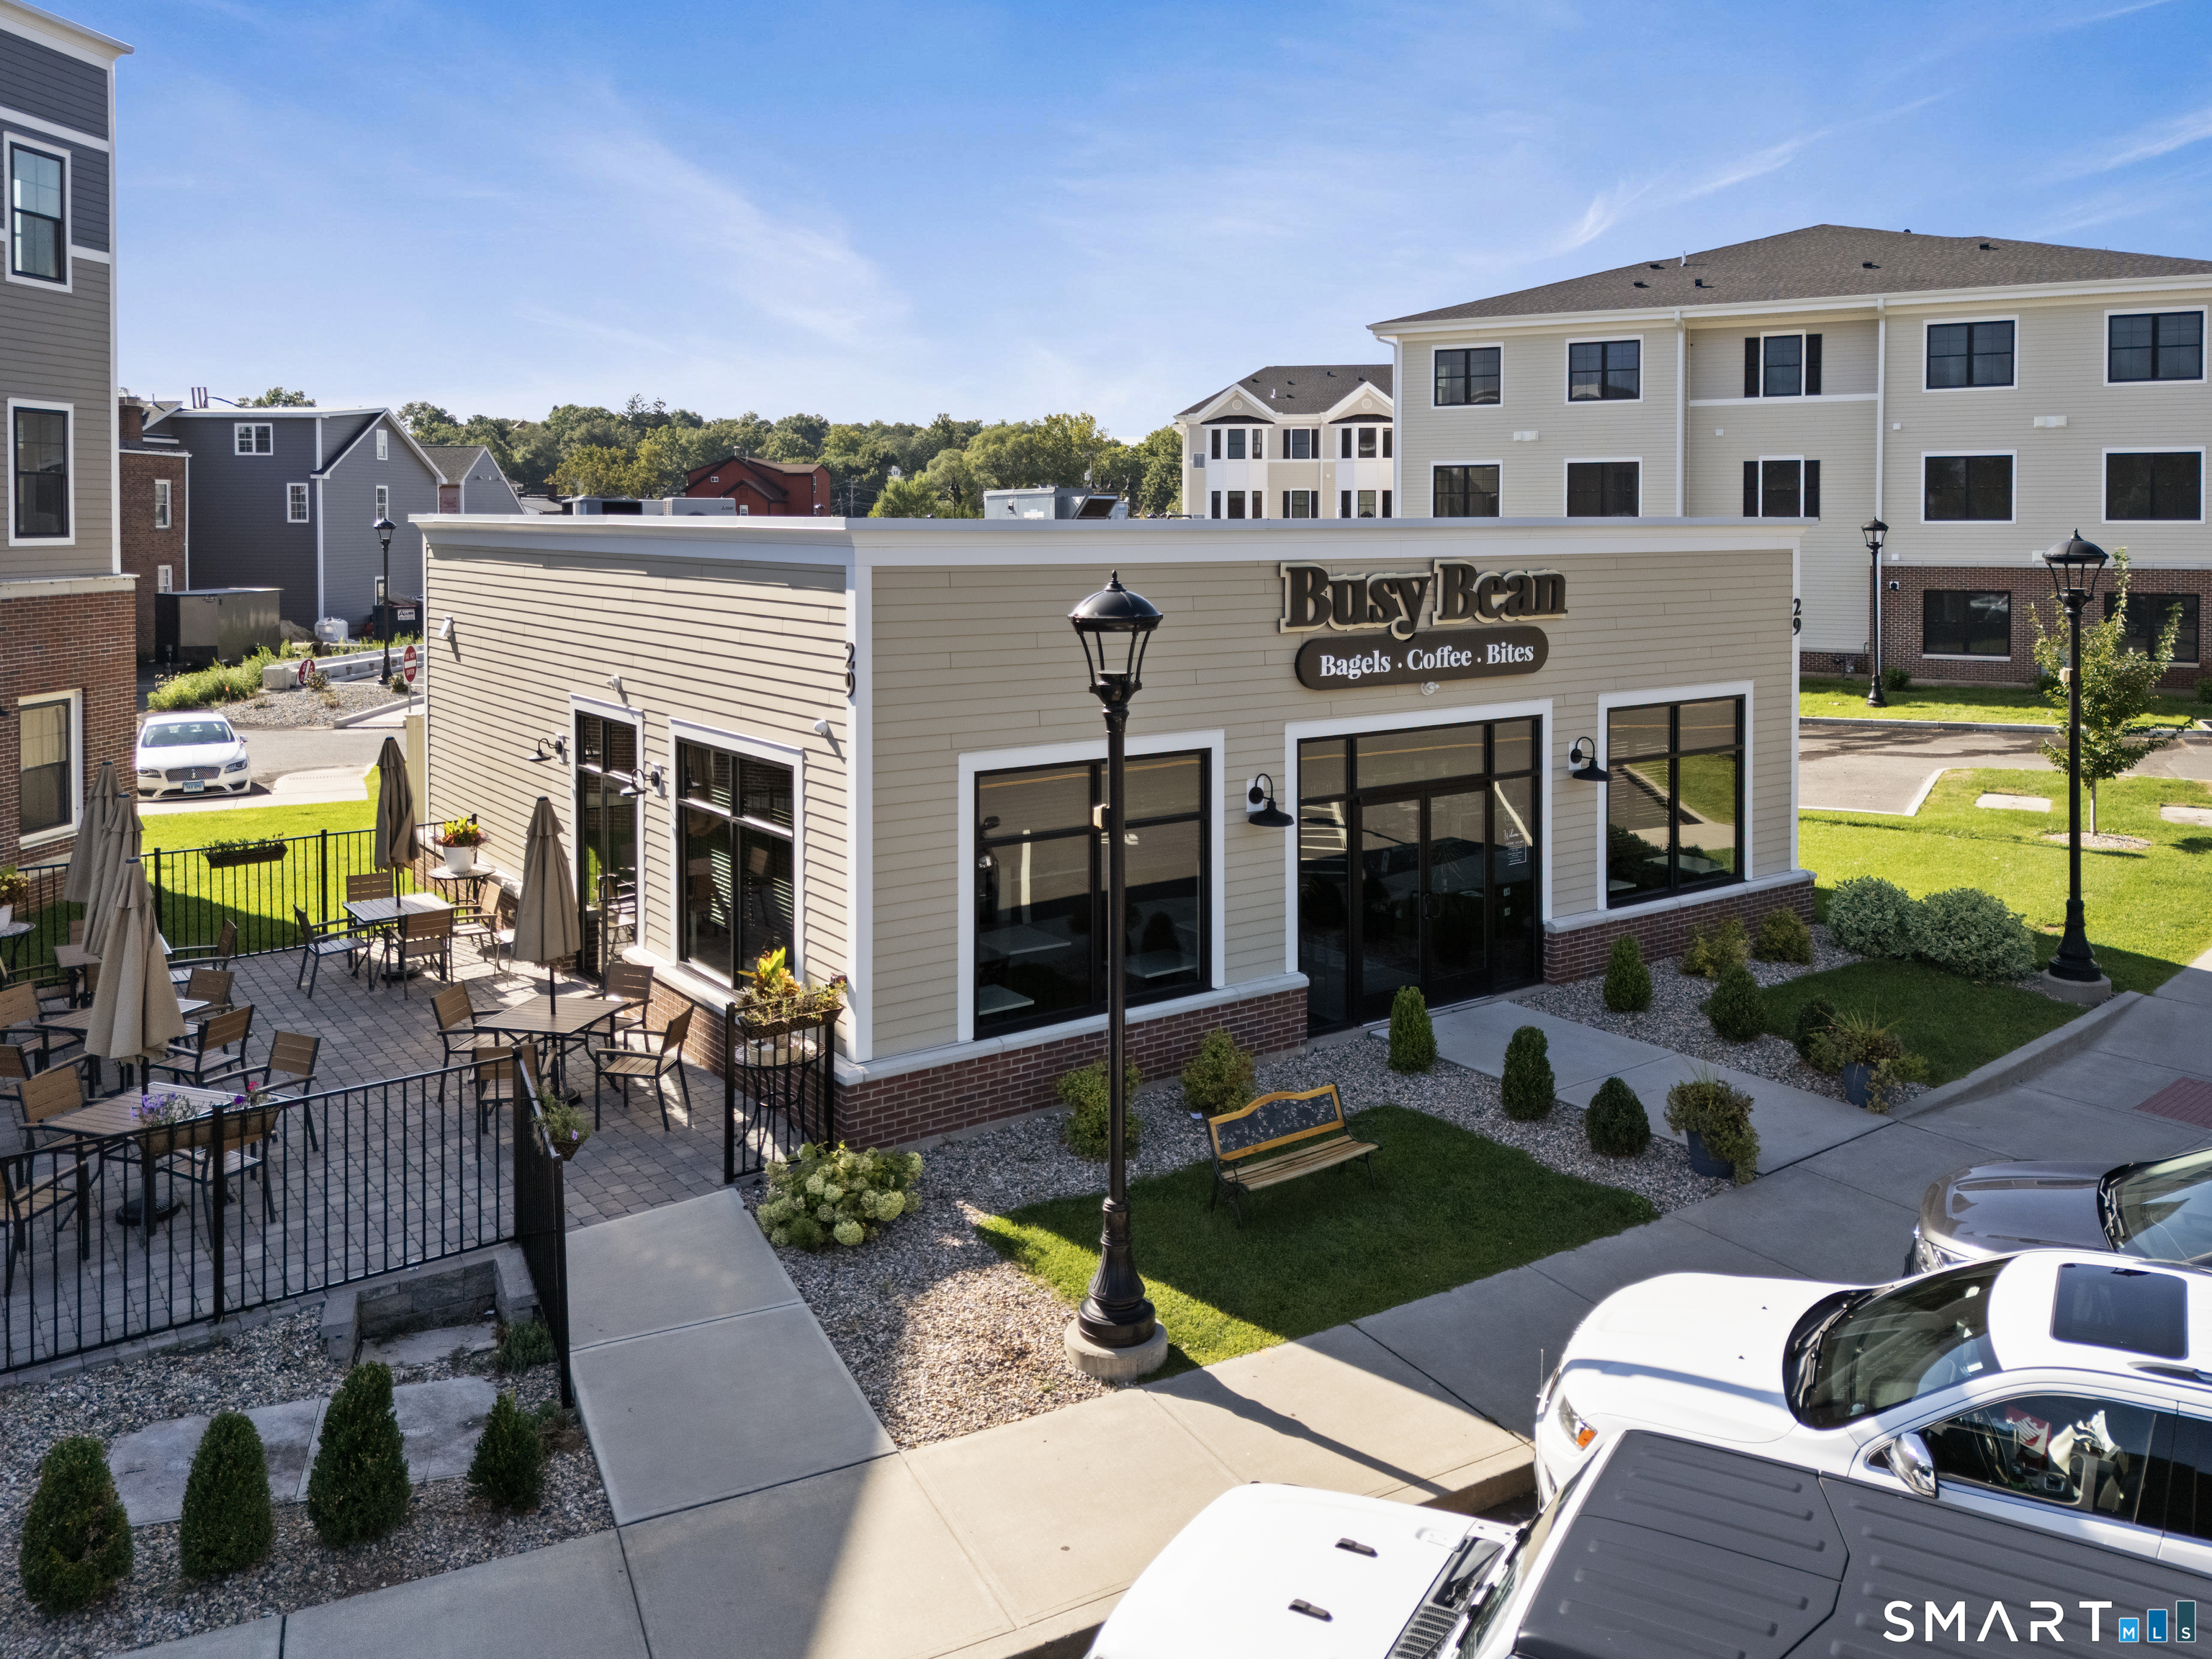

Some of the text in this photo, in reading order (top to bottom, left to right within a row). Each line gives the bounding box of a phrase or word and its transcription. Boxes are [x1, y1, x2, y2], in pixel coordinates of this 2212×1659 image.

[1280, 559, 1568, 640] Busy Bean
[1793, 598, 1802, 635] 29
[845, 642, 855, 698] 29
[1319, 642, 1534, 679] Bagels Coffee Bites
